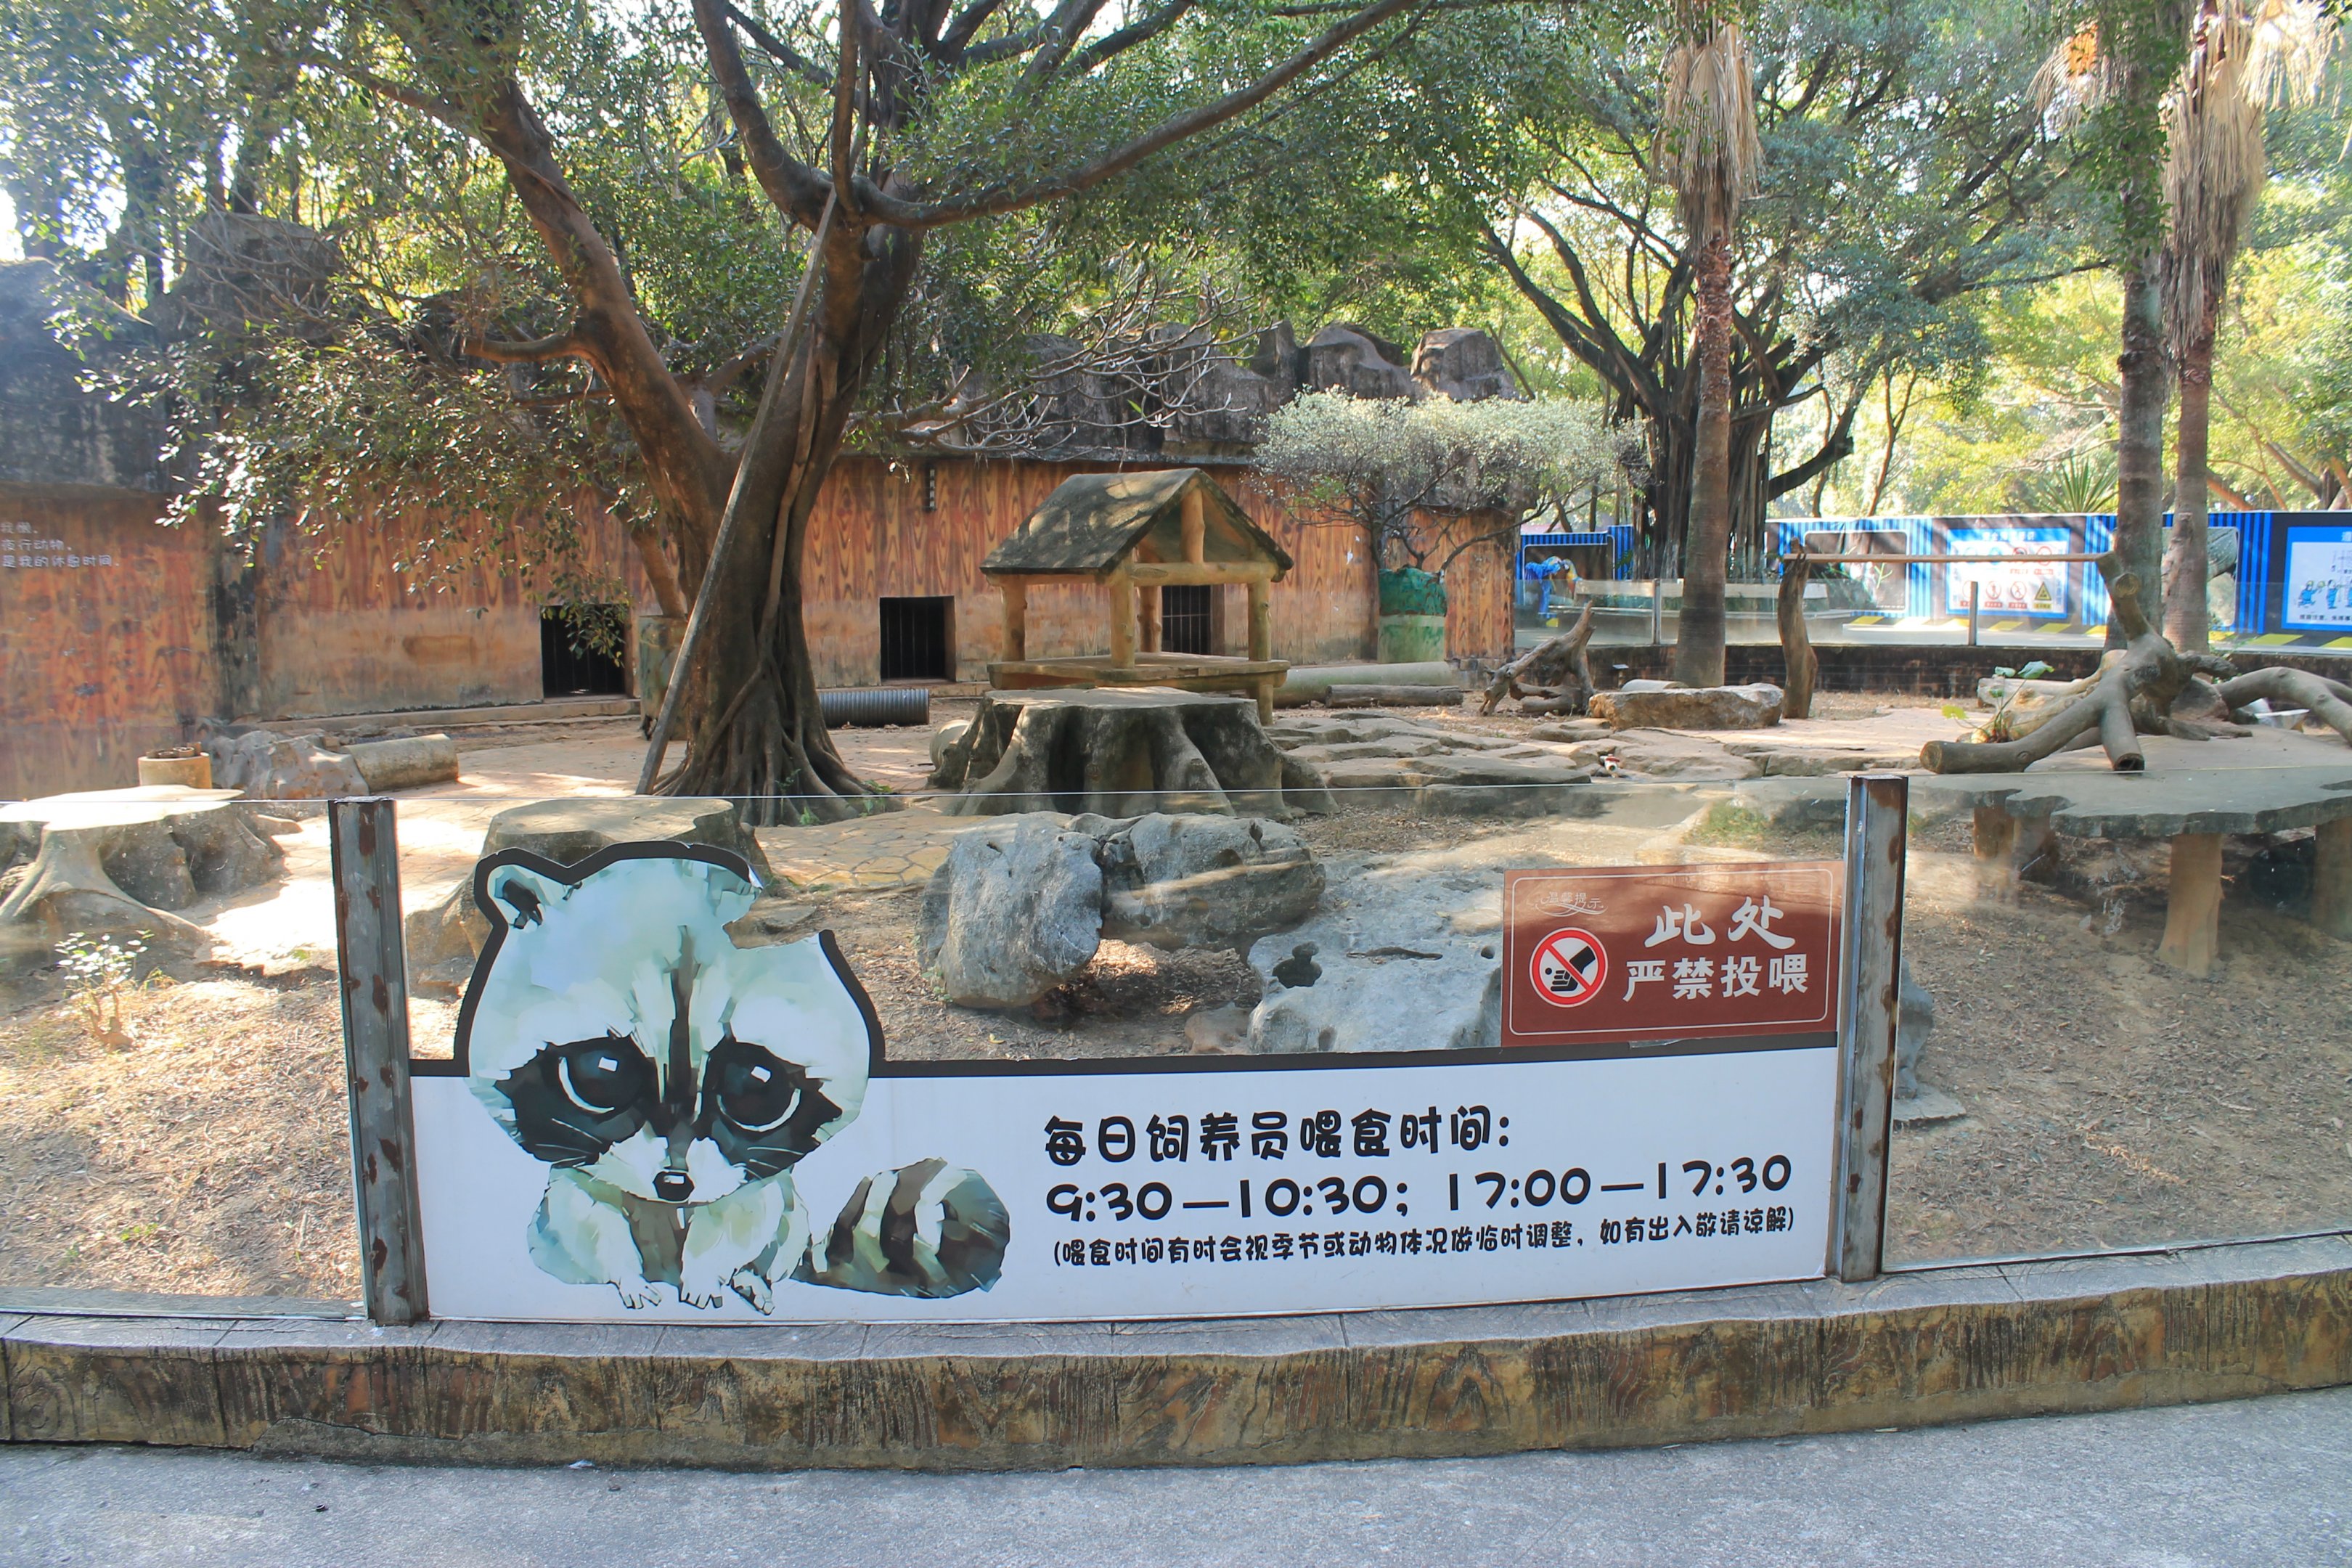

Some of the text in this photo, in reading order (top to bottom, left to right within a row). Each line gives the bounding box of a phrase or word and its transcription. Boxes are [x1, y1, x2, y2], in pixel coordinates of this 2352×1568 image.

[1540, 891, 1604, 910] 温馨提示
[1643, 894, 1796, 950] 此处
[1622, 952, 1809, 1003] 严禁投喂
[1043, 1105, 1510, 1167] 每日饲养员喂食时间：
